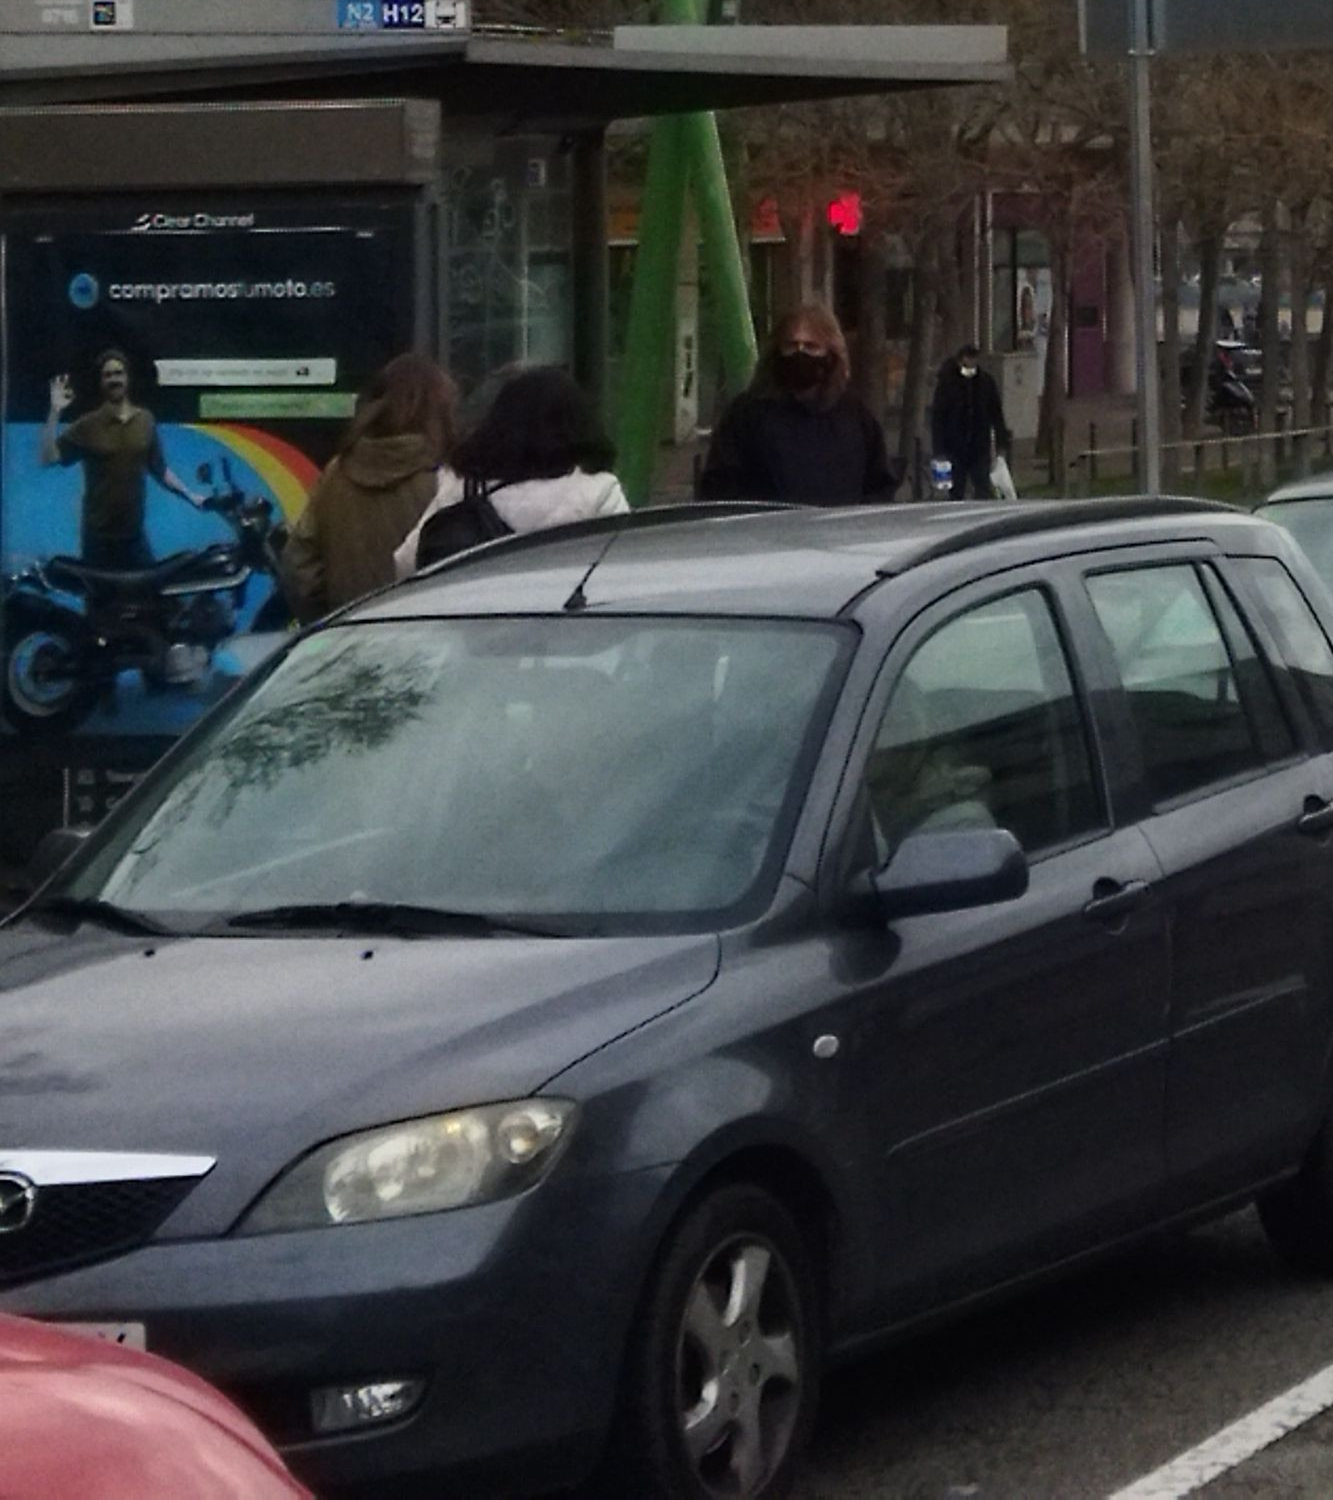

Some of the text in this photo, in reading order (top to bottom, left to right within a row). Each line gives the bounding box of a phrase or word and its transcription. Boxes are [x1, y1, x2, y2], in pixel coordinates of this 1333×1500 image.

[346, 2, 375, 21] N2
[383, 2, 424, 23] H12
[152, 212, 255, 228] Clear Channel
